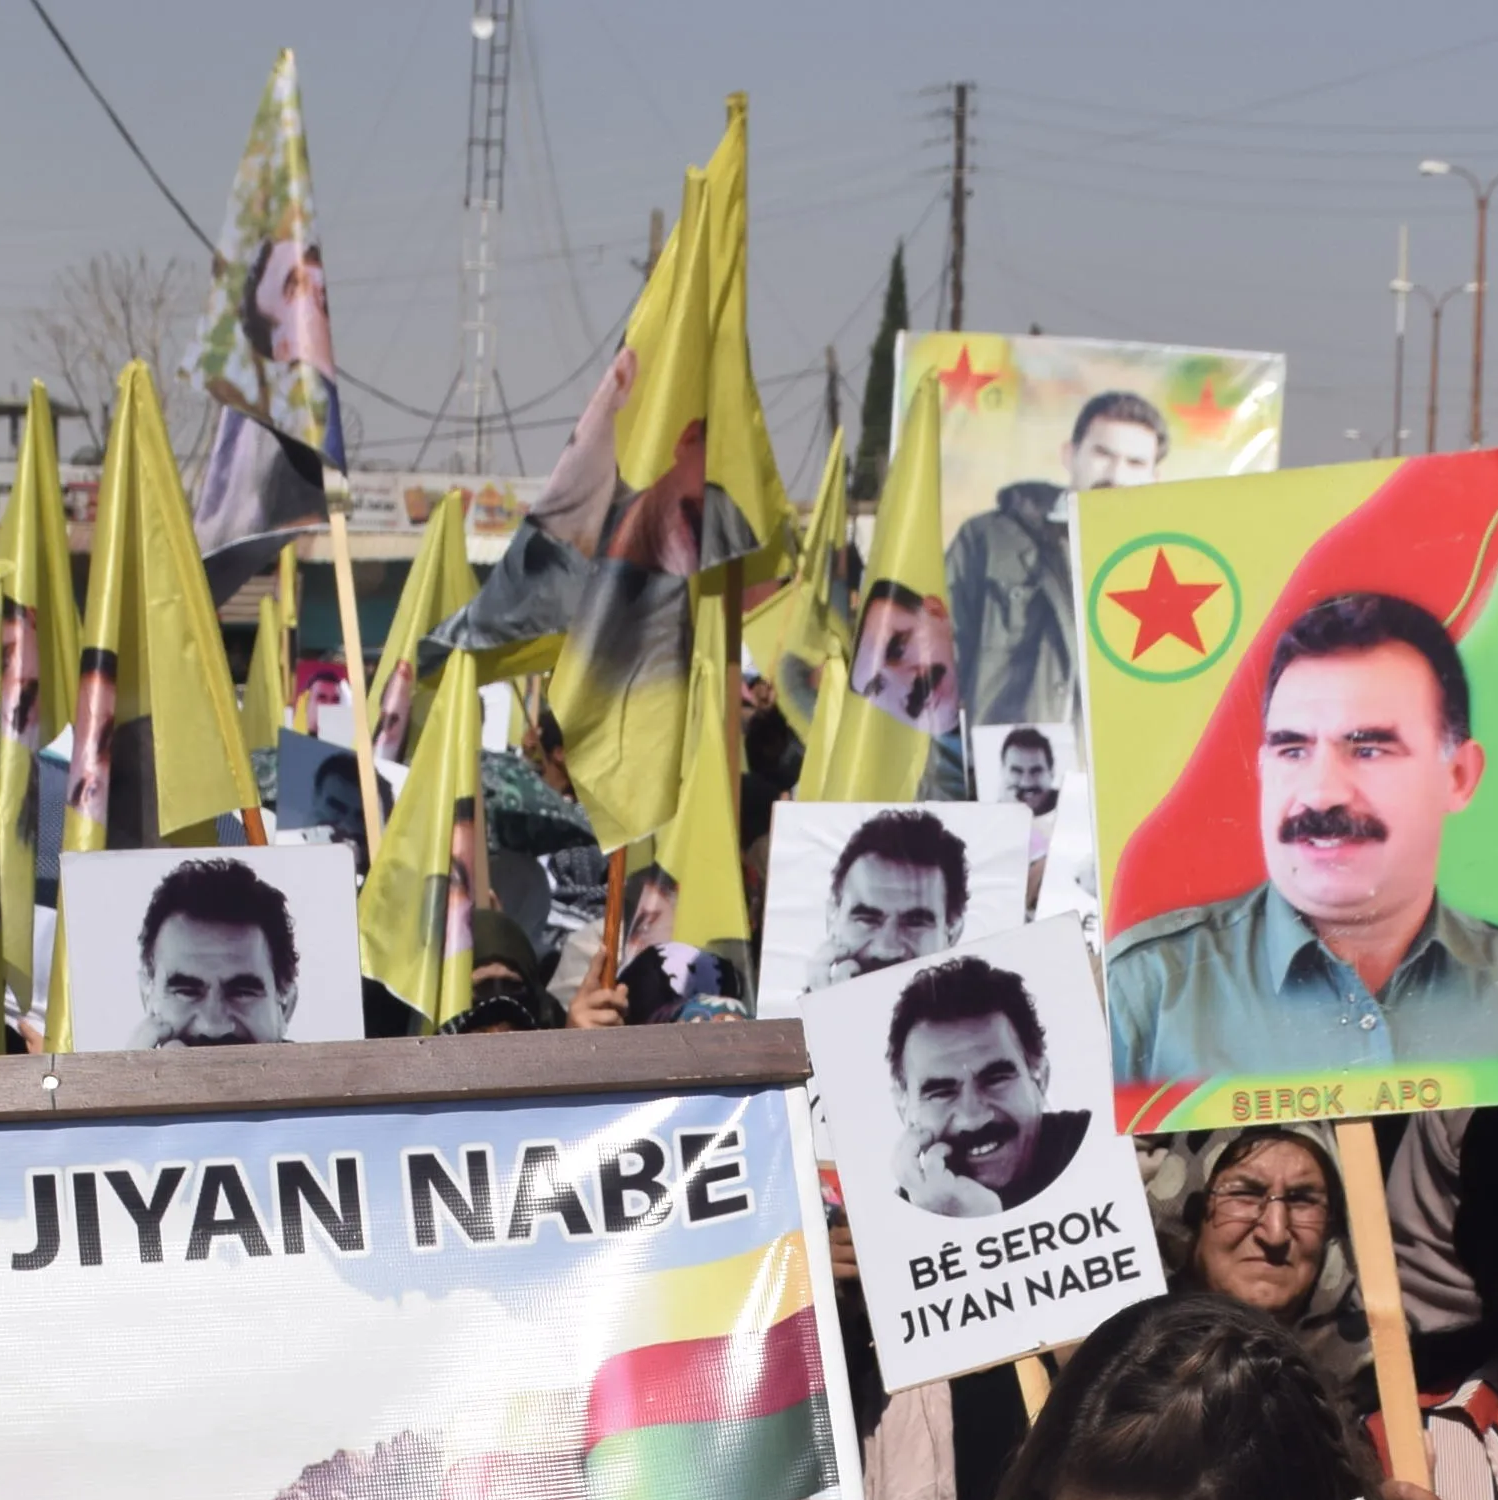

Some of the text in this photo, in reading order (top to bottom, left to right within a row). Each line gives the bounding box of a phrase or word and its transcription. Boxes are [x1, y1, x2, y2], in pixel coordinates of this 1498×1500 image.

[1232, 1078, 1441, 1121] SEROK APO
[11, 1157, 365, 1271] JIYAN
[408, 1130, 749, 1248] NABE
[909, 1202, 1121, 1291] BÊ SEROK
[901, 1246, 1141, 1344] JIYAN NABE
